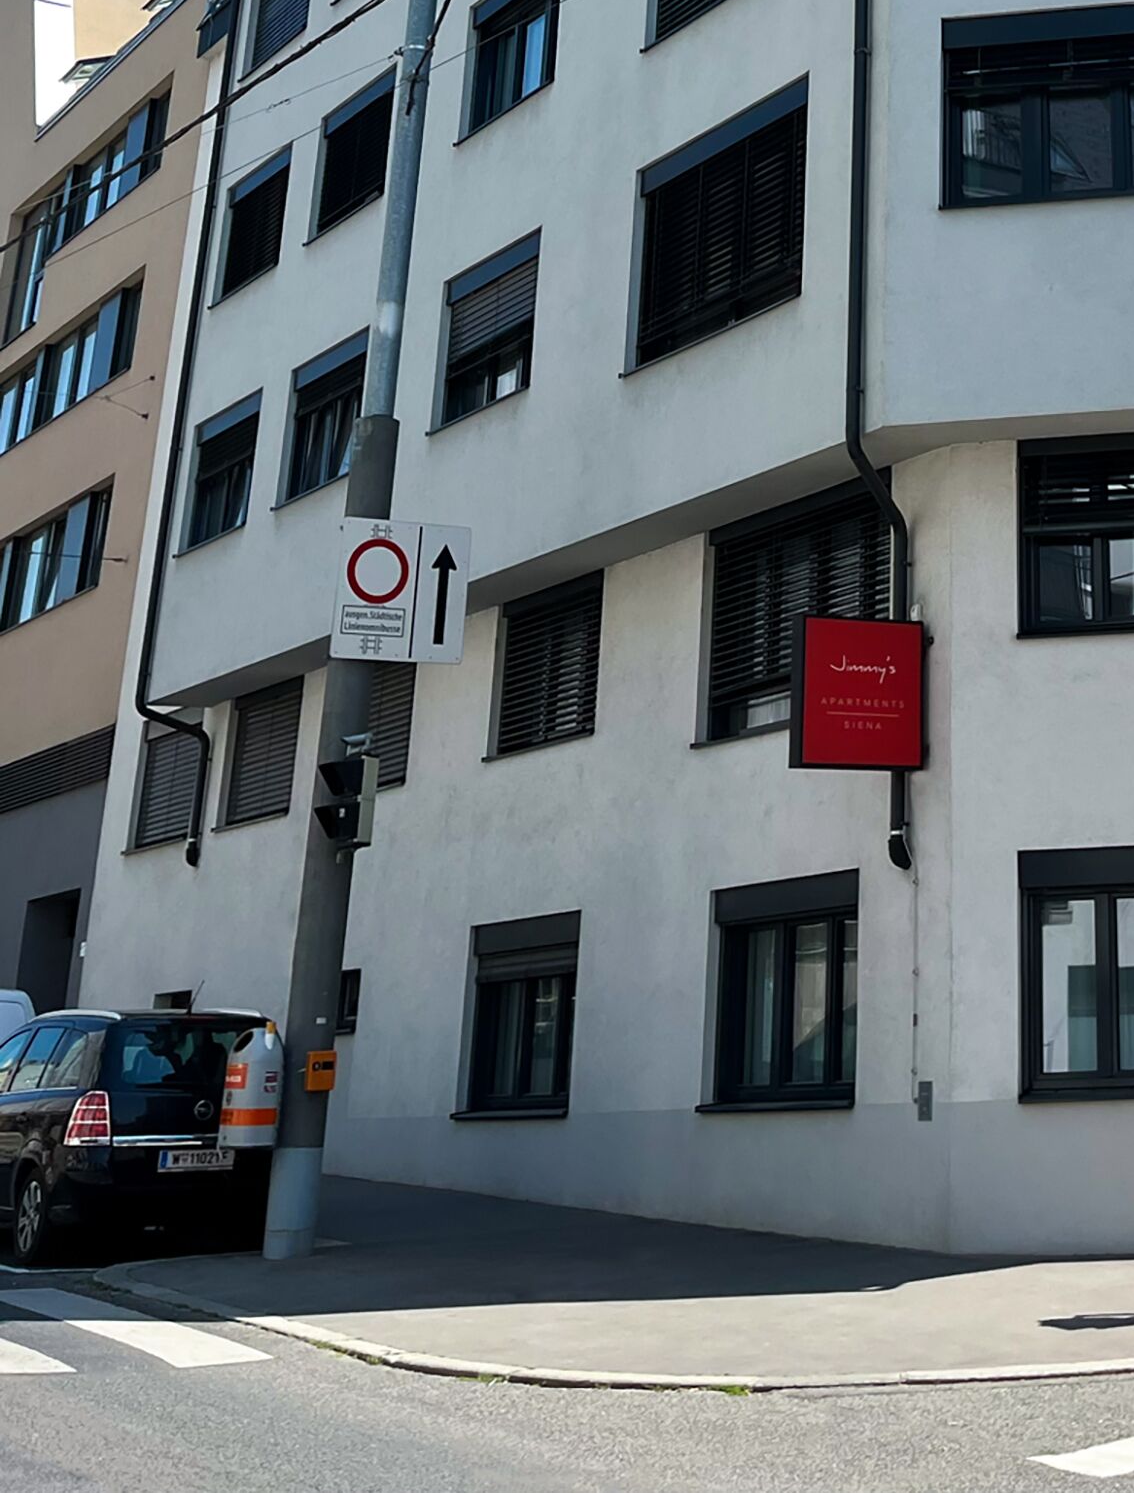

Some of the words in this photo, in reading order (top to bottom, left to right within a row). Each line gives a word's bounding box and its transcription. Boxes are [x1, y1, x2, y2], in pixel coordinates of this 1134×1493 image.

[830, 655, 896, 684] Jimmy's
[820, 697, 905, 709] APARTMENTS
[844, 721, 882, 730] SIENA
